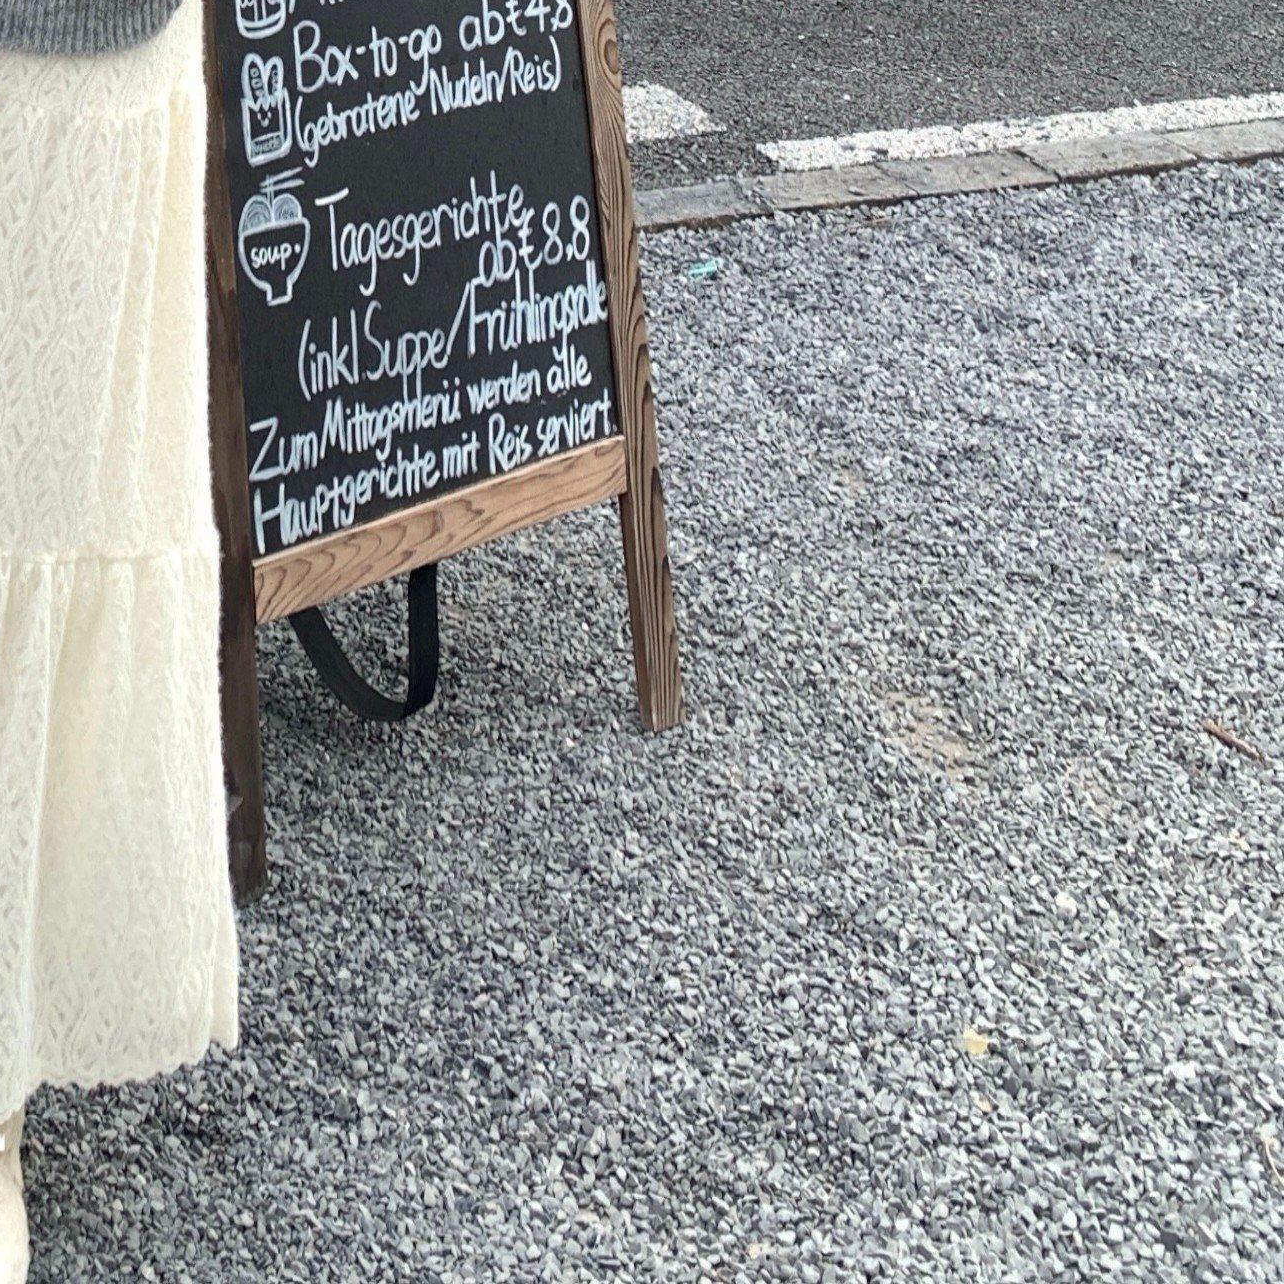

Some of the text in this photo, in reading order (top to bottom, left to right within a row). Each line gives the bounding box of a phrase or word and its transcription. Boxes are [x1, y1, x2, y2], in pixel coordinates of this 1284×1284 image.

[293, 20, 442, 94] Box-to-go
[314, 169, 528, 296] Tagesgerichte
[249, 345, 593, 482] Zum Mittagsmenü werden alle
[253, 443, 441, 554] Hauptgerichte
[442, 430, 481, 480] mit
[488, 413, 533, 475] Reis
